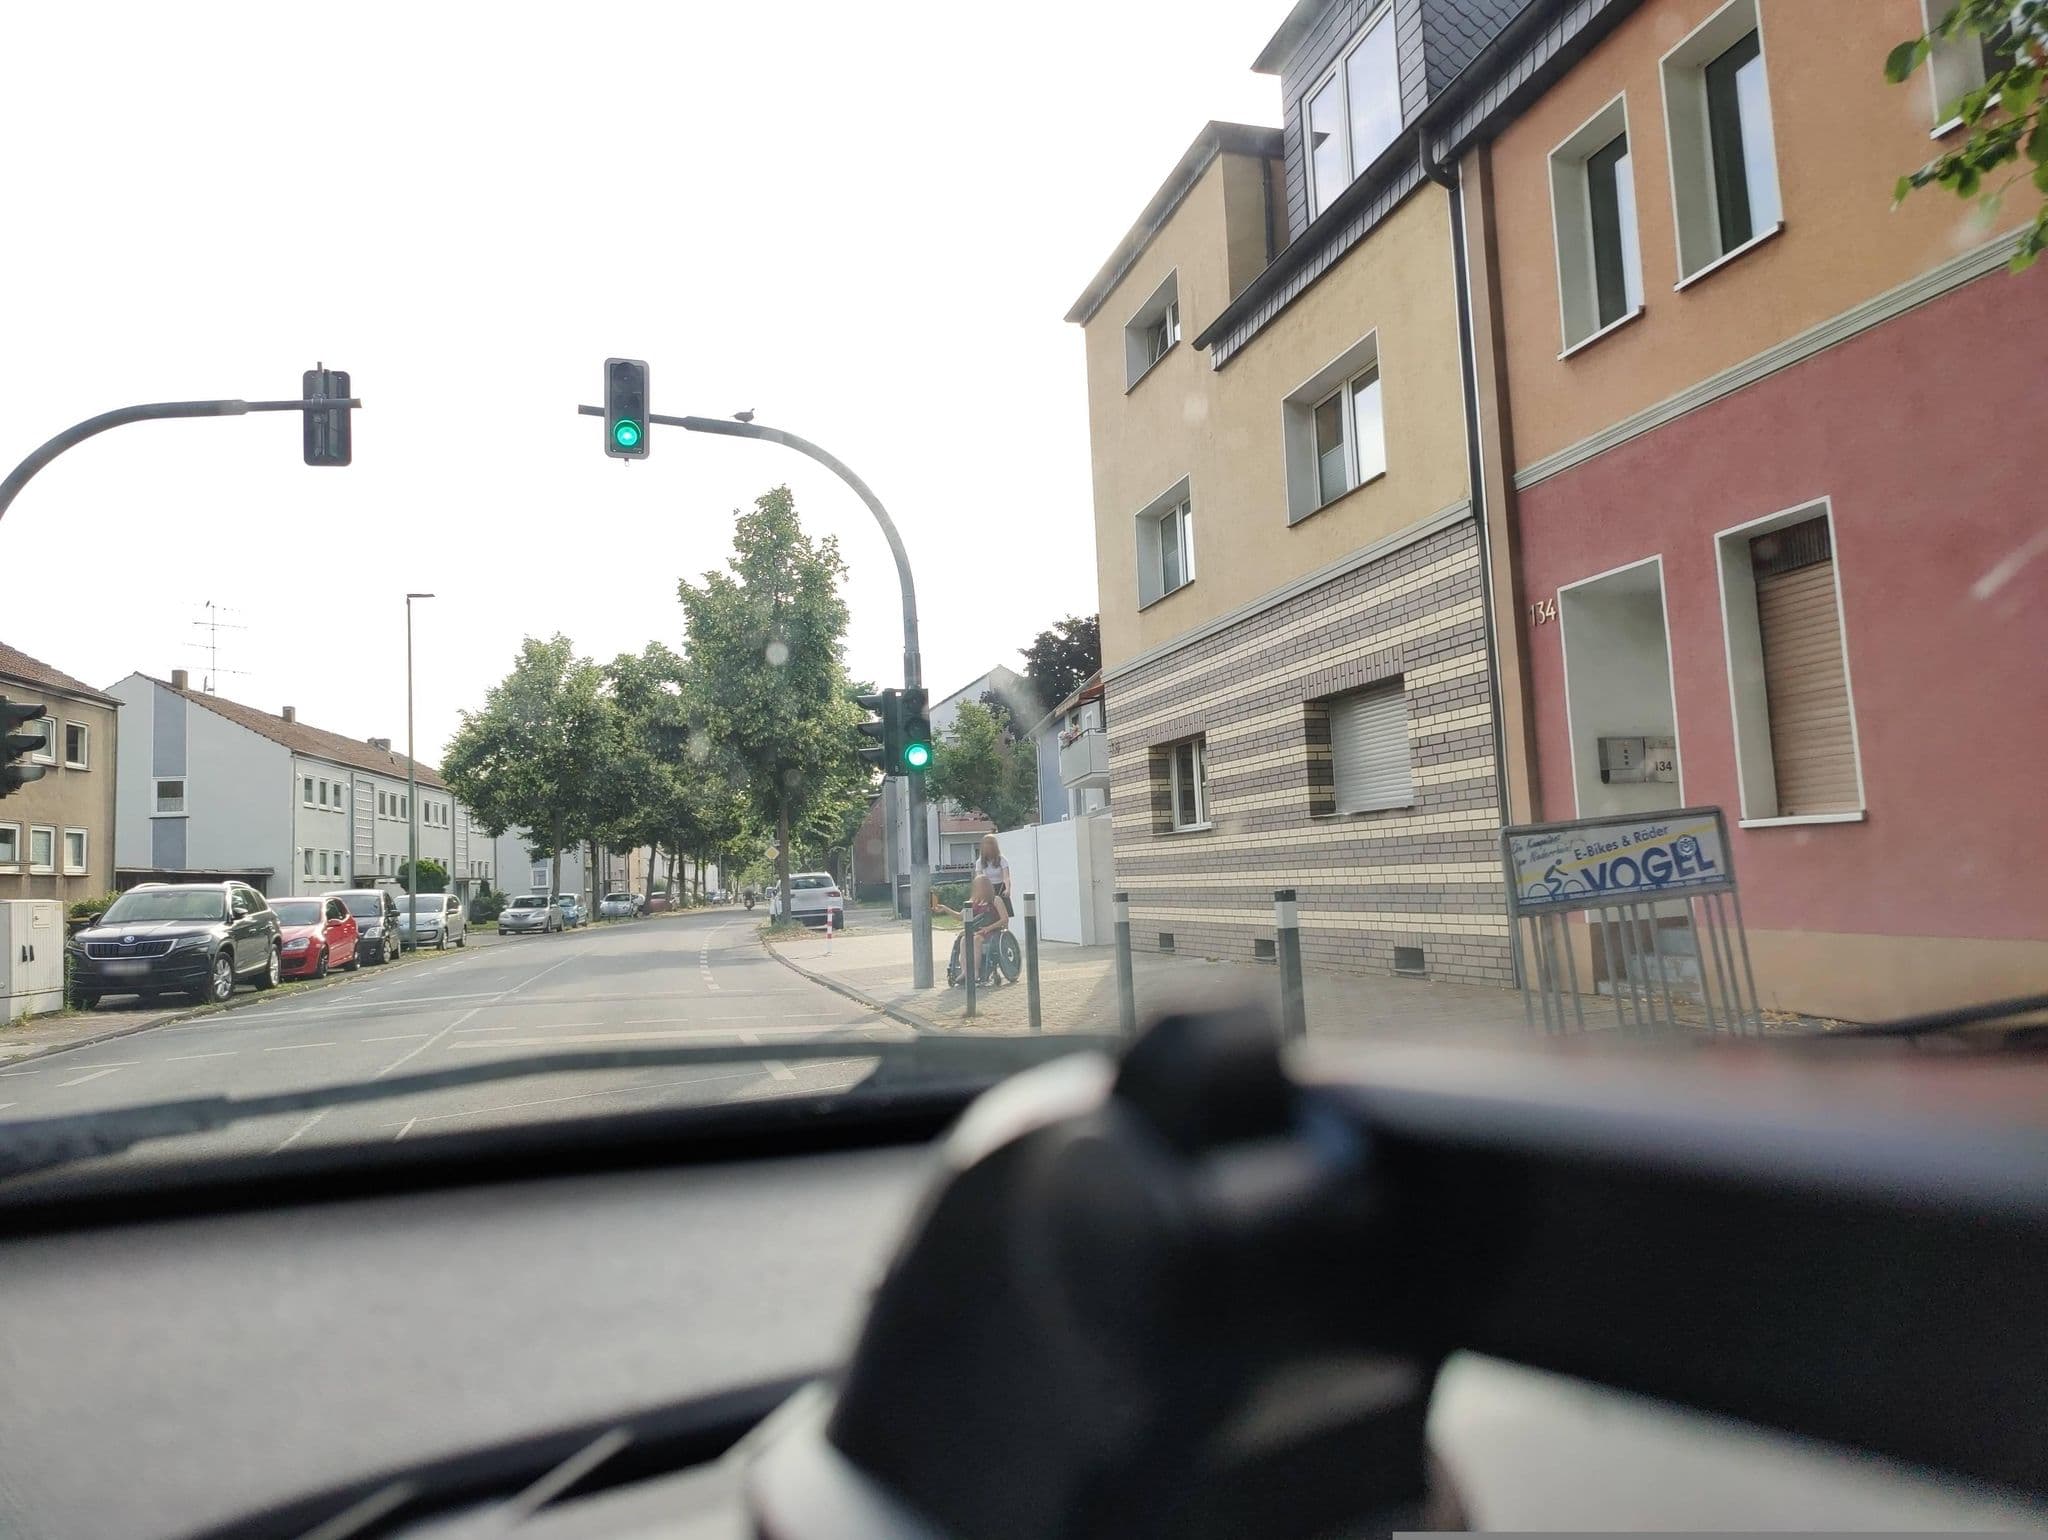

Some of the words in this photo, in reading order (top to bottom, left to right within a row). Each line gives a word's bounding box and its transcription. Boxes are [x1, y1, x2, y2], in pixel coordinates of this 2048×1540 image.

[1530, 598, 1556, 627] 134
[1655, 761, 1672, 771] 134
[1574, 841, 1619, 861] E-Bikes
[1622, 835, 1631, 847] &
[1580, 836, 1715, 891] VOGEL
